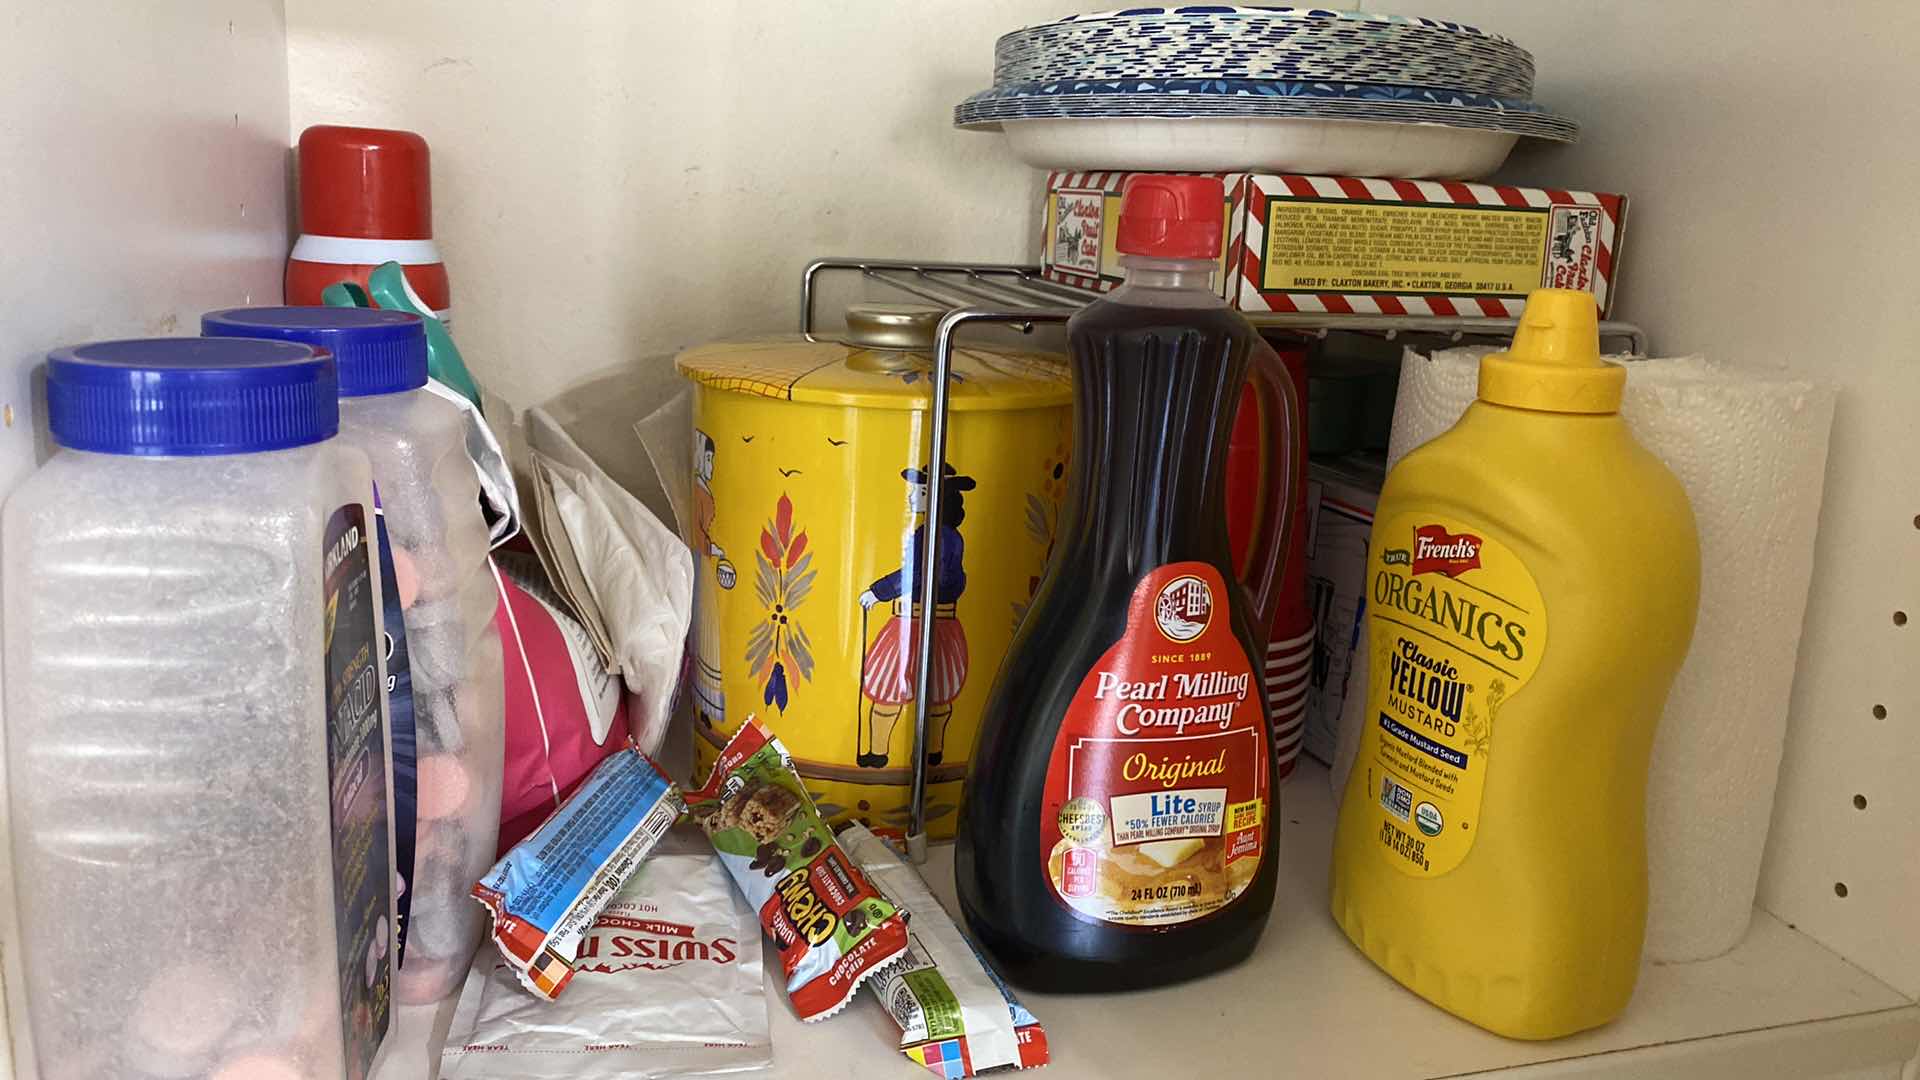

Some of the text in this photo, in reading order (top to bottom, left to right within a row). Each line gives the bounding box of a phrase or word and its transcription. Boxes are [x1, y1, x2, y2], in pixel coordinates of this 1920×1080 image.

[1294, 278, 1316, 287] BAKED
[1331, 279, 1362, 287] CLAXTON
[1444, 281, 1472, 290] GEORGIA
[1416, 536, 1476, 560] French's
[1375, 571, 1526, 661] ORGANICS
[1152, 652, 1212, 664] SINCE 1889
[1398, 637, 1458, 680] Classic
[1094, 670, 1249, 700] Pearl Milling
[1390, 650, 1466, 723] YELLOW
[1116, 702, 1235, 735] Company
[1388, 694, 1455, 737] MUSTARD
[1390, 724, 1410, 740] Grade
[1410, 734, 1440, 755] Mustard
[1440, 749, 1460, 764] Seed
[1122, 749, 1227, 788] Original
[1410, 765, 1435, 785] Mustard
[1436, 778, 1454, 794] Seeds
[1418, 758, 1443, 777] Blended
[1444, 770, 1458, 783] with
[1151, 795, 1221, 817] Lite SYRUP
[1421, 808, 1438, 821] USDA
[1152, 816, 1178, 828] FEWER
[1180, 813, 1216, 826] CALORIES
[1234, 817, 1257, 830] RECIPE
[1116, 832, 1130, 841] THAN
[1130, 830, 1144, 840] PEARL
[1145, 828, 1164, 838] MILLING
[1384, 820, 1394, 834] NET
[1396, 828, 1406, 841] WT
[1416, 840, 1425, 855] OZ
[1412, 850, 1424, 866] 850
[1132, 889, 1142, 900] 24
[1144, 888, 1154, 900] FL
[1156, 887, 1168, 898] OZ
[1170, 885, 1186, 900] (710
[640, 904, 658, 912] HOT
[646, 923, 679, 934] MILK
[610, 936, 737, 964] SWISS
[828, 937, 878, 986] CHOCOLATE
[846, 958, 864, 980] CHIP
